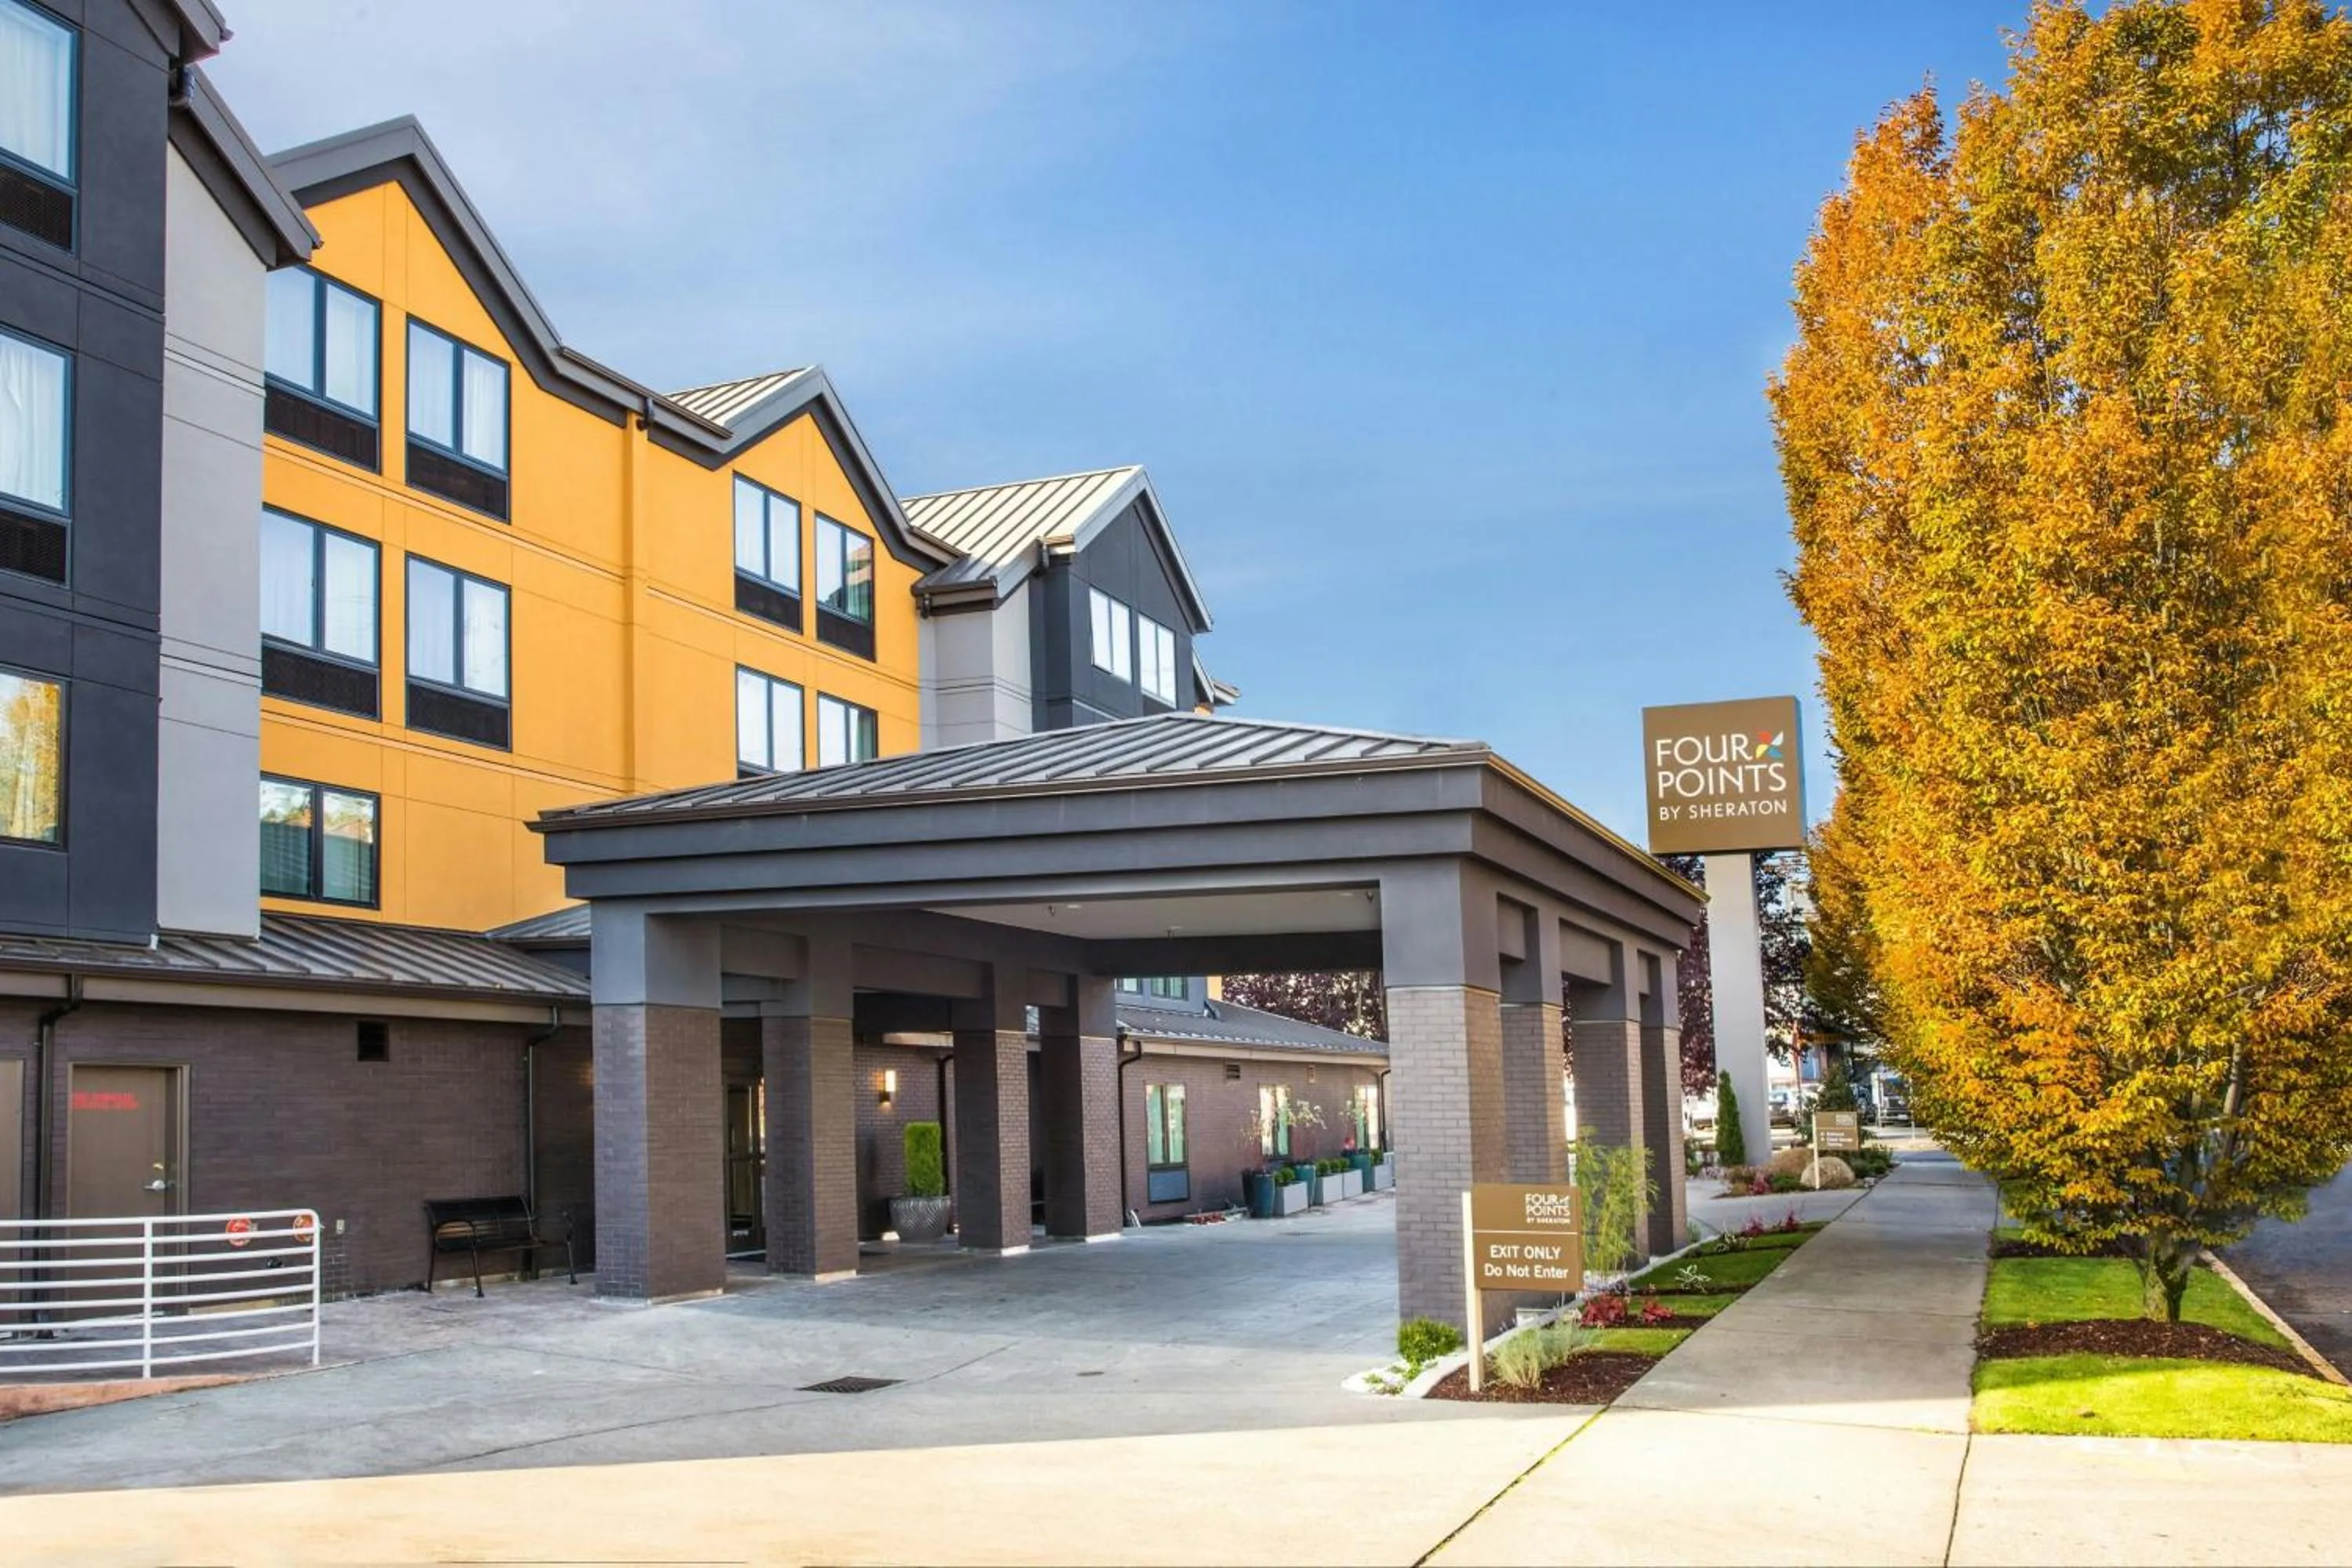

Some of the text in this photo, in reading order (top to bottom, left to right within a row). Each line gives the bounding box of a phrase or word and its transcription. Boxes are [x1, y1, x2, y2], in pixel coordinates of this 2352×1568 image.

[1656, 734, 1753, 767] FOUR
[1657, 763, 1787, 799] POINTS
[1660, 799, 1787, 821] BY SHERATON
[1525, 1193, 1559, 1205] FOUR
[1526, 1205, 1570, 1216] POINTS
[1490, 1245, 1561, 1260] EXIT ONLY
[1484, 1263, 1569, 1279] Do Not Enter
